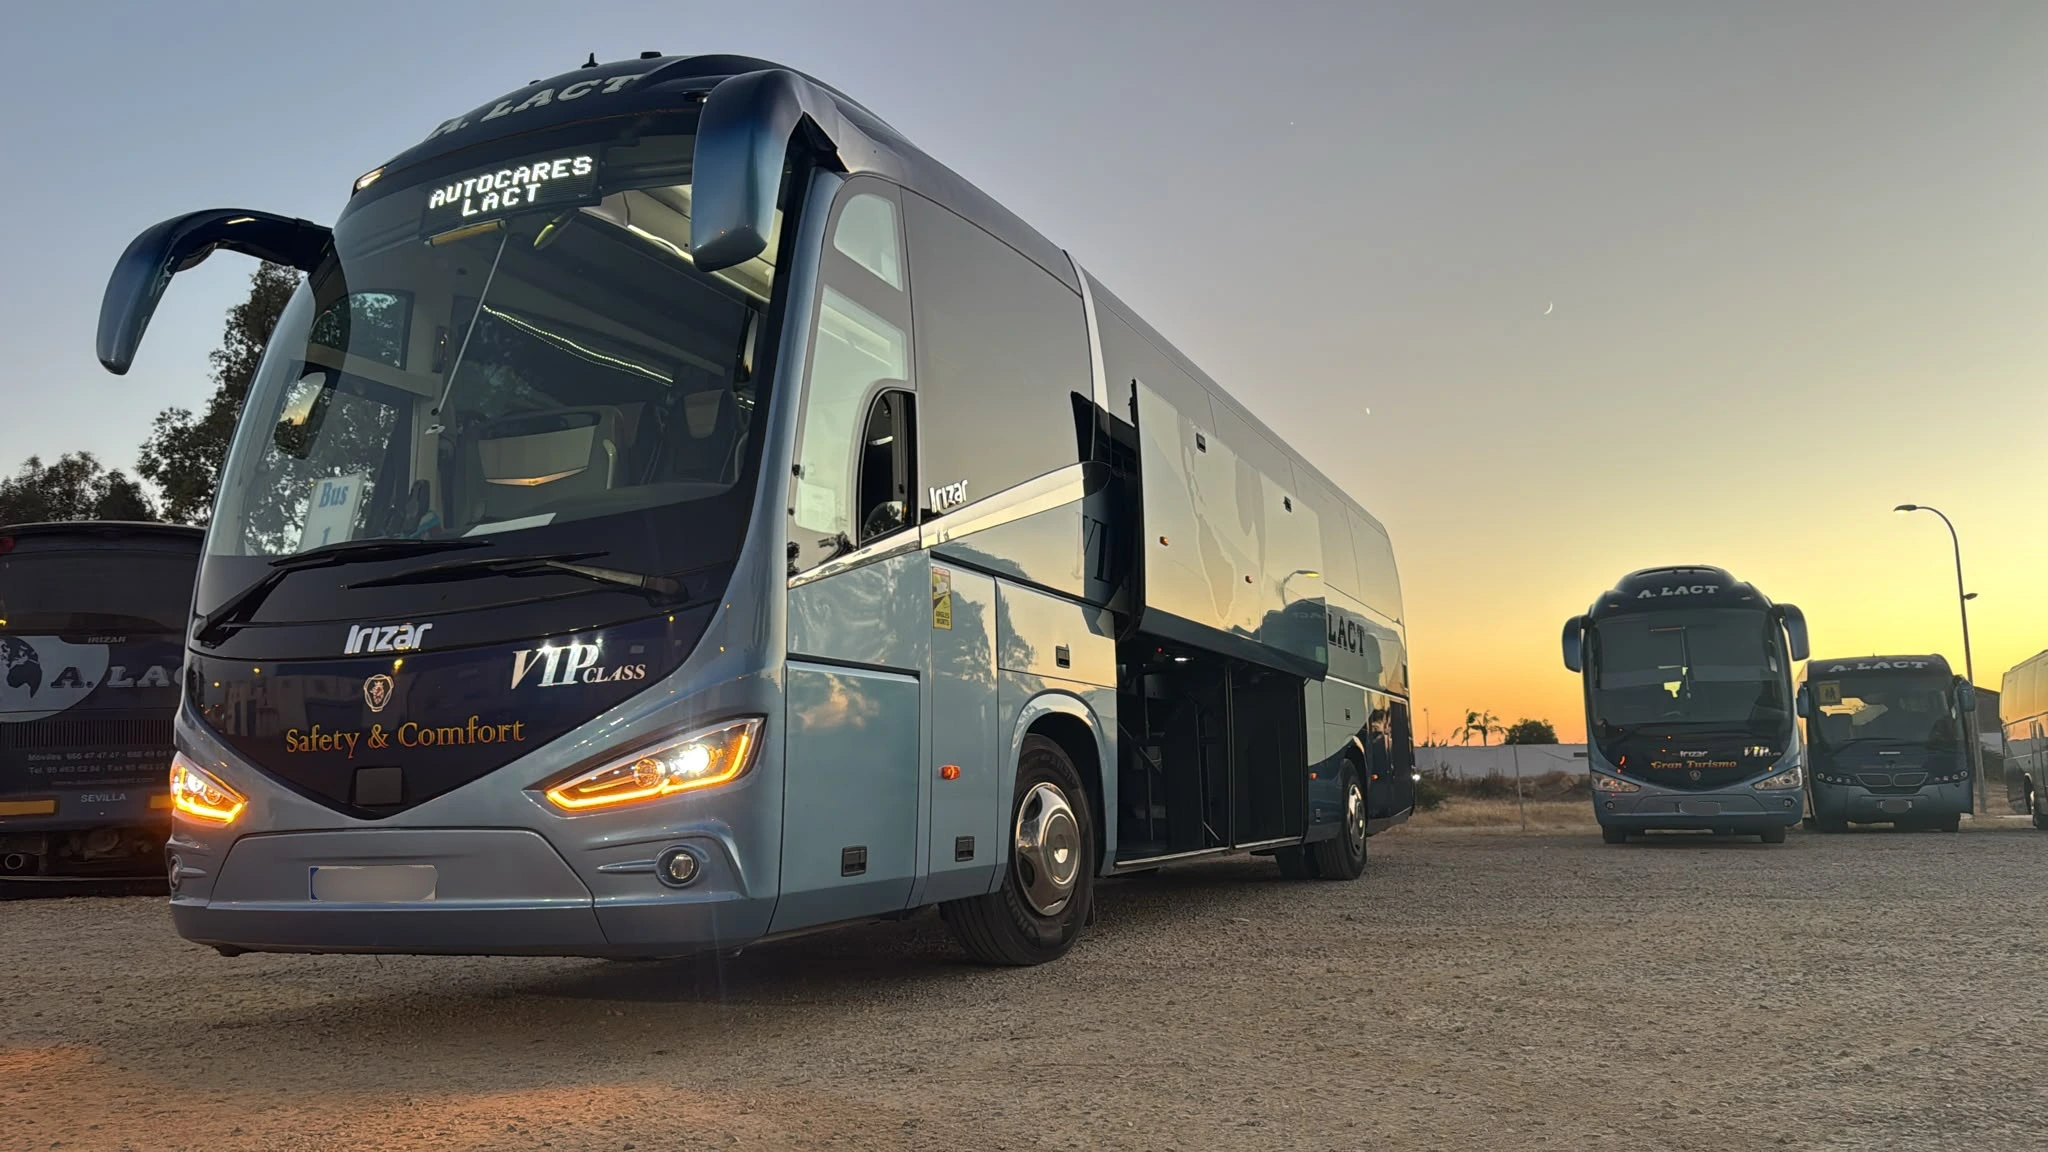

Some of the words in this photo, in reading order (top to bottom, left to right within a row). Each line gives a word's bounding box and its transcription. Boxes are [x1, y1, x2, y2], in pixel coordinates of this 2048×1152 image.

[480, 73, 645, 122] LACT
[429, 156, 592, 210] AUTOCARES
[462, 183, 541, 217] LACT
[319, 482, 348, 508] Bus
[929, 479, 968, 513] Irizar
[1637, 589, 1656, 599] A.
[1661, 585, 1719, 597] LACT
[344, 623, 433, 654] Irizar
[1328, 611, 1365, 656] LACT
[51, 666, 94, 688] A.
[510, 644, 599, 690] VIP
[583, 664, 646, 684] CLASS
[1828, 664, 1851, 673] A.
[1857, 661, 1929, 670] LACT
[286, 724, 360, 758] Safety
[368, 723, 389, 749] &
[398, 715, 526, 748] Comfort
[1653, 761, 1682, 769] Gran
[1687, 759, 1737, 769] Turismo
[80, 793, 126, 803] SEVILLA
